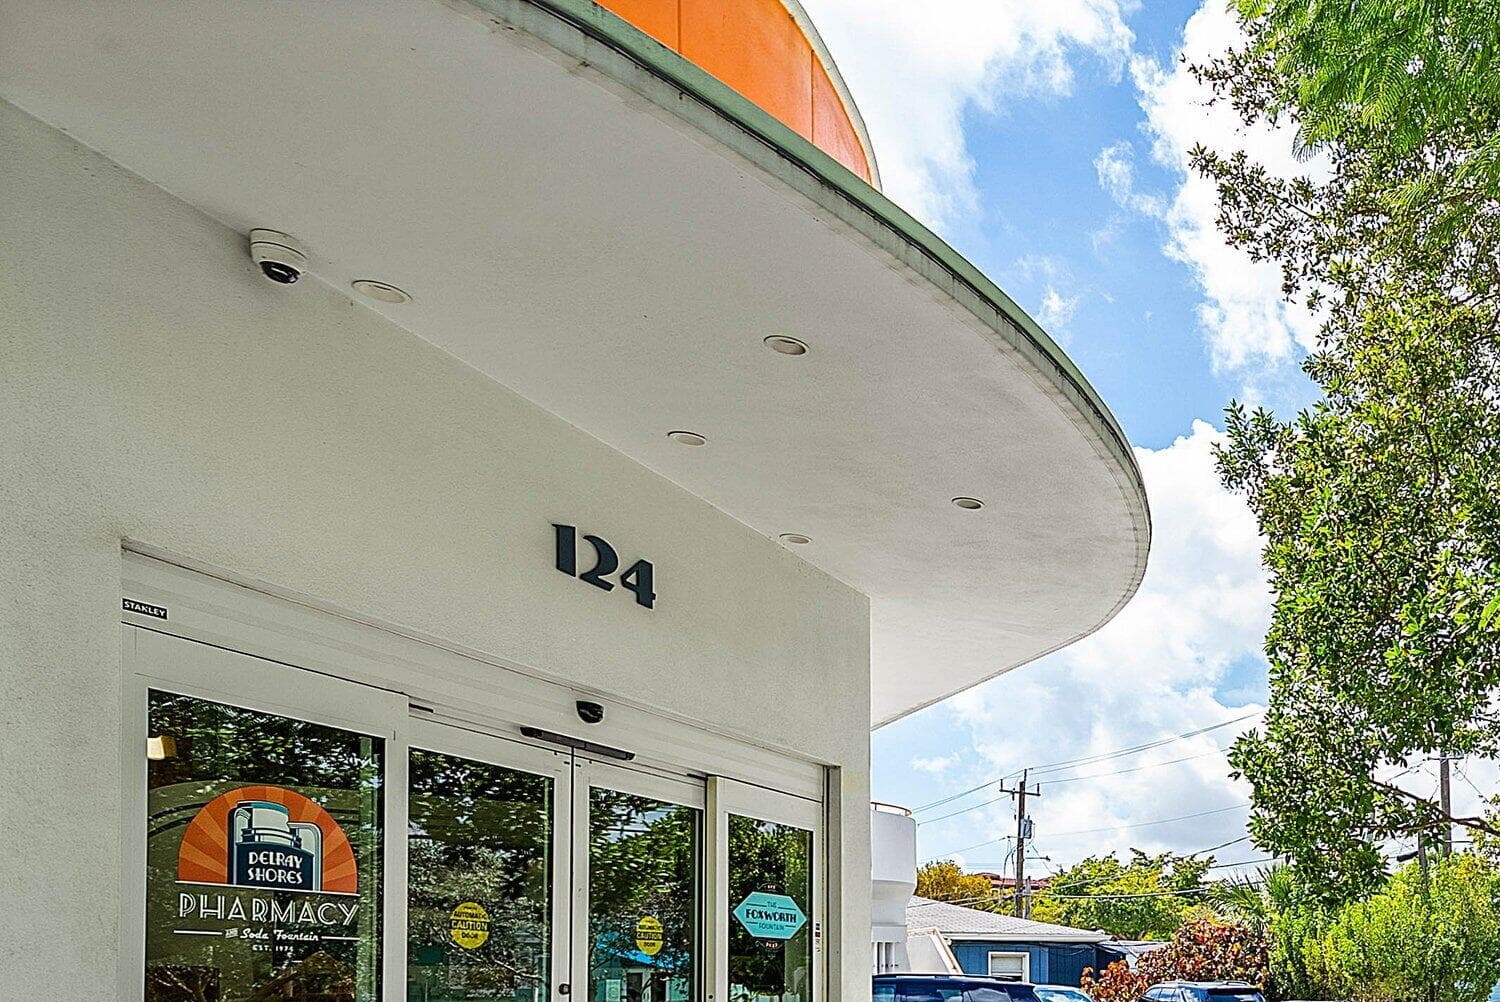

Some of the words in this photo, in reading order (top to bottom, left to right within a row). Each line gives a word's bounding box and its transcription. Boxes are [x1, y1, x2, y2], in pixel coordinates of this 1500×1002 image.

[551, 523, 657, 610] 124
[124, 601, 166, 616] STANLEY
[248, 851, 303, 869] DELRAY
[247, 866, 303, 885] SHORES
[179, 892, 360, 926] PHARMACY
[745, 908, 797, 923] FOXWORTH
[451, 920, 488, 931] CAUTION
[240, 927, 270, 939] Soda
[273, 929, 319, 941] Fountain
